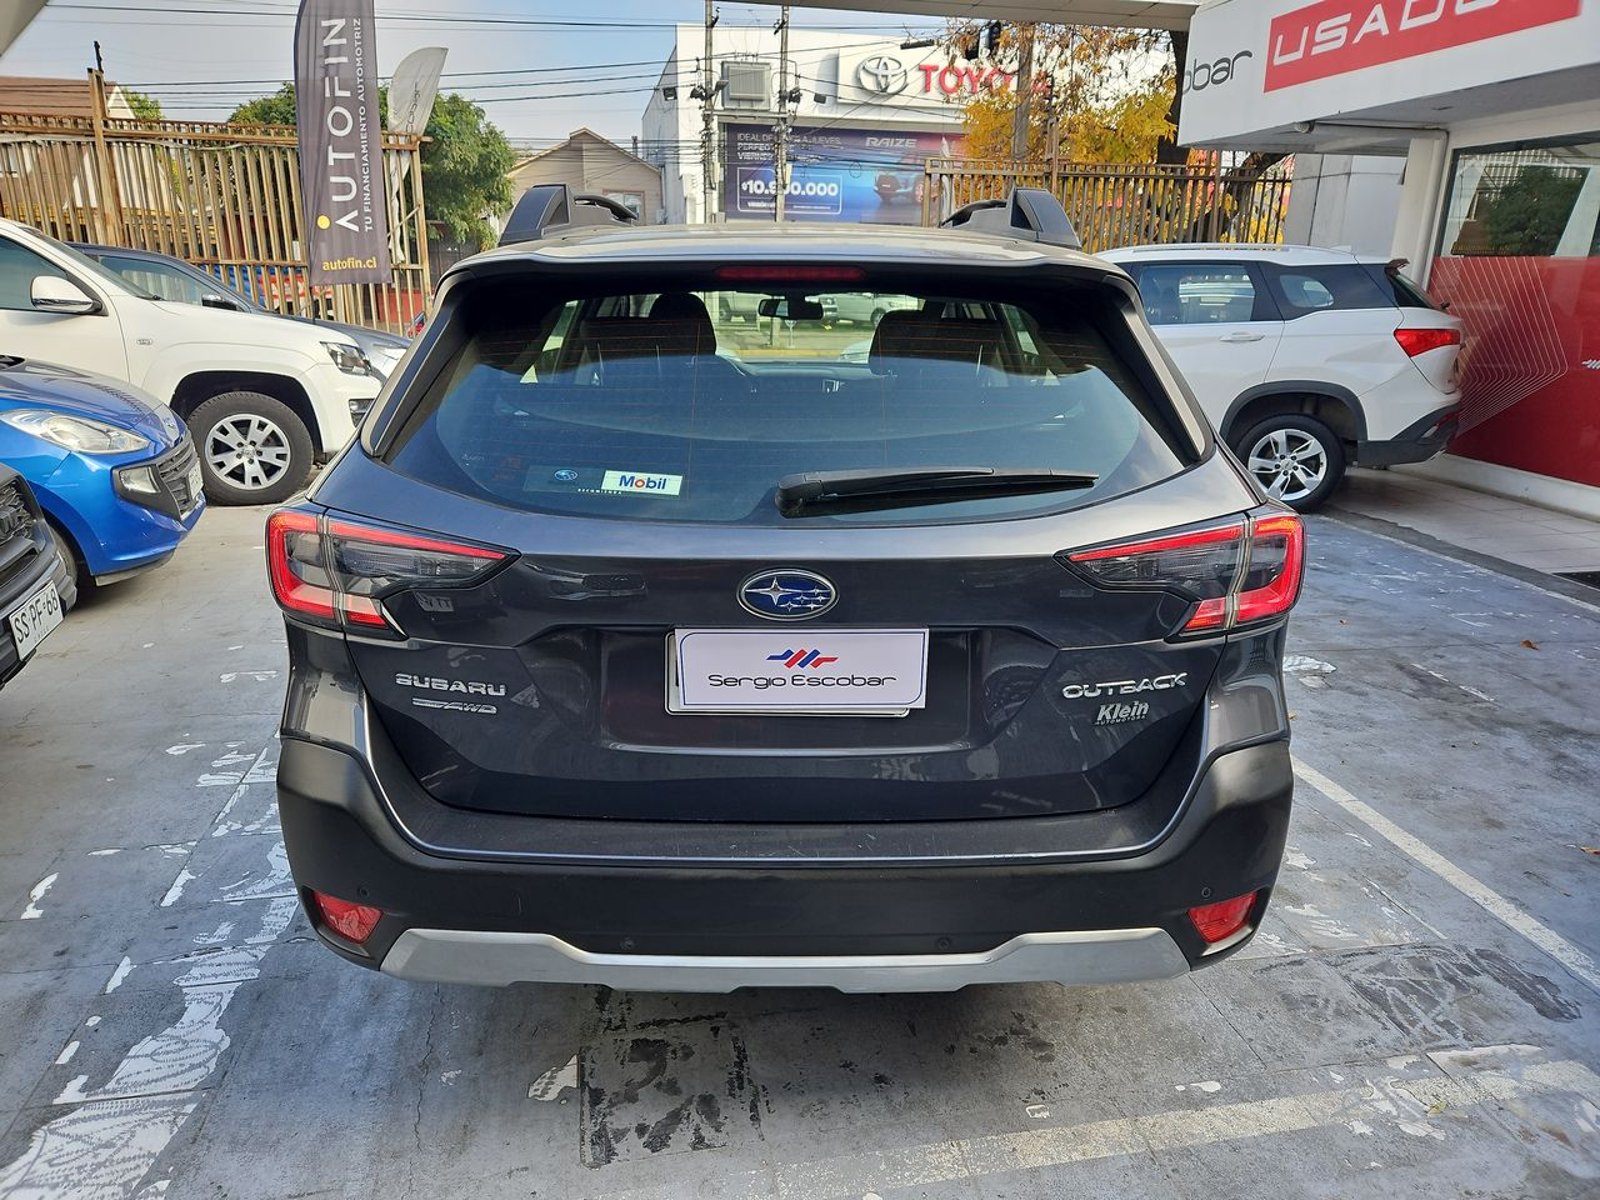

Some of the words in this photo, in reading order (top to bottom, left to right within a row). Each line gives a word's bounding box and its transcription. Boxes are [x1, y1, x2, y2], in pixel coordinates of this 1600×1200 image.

[353, 18, 366, 102] AUTOMOTRIZ
[919, 64, 1051, 94] TOYO
[321, 18, 360, 232] AUTOFIN
[865, 136, 918, 148] RAIZE
[359, 105, 372, 213] FINANCIAMIENTO
[364, 216, 374, 232] TU
[322, 256, 377, 271] autofin.cl
[618, 475, 668, 490] Mobil
[395, 672, 506, 697] SUBARU
[708, 674, 787, 690] Sergio
[791, 674, 898, 687] Escobar
[1062, 672, 1187, 699] OUTBACK
[1096, 700, 1150, 721] Klein
